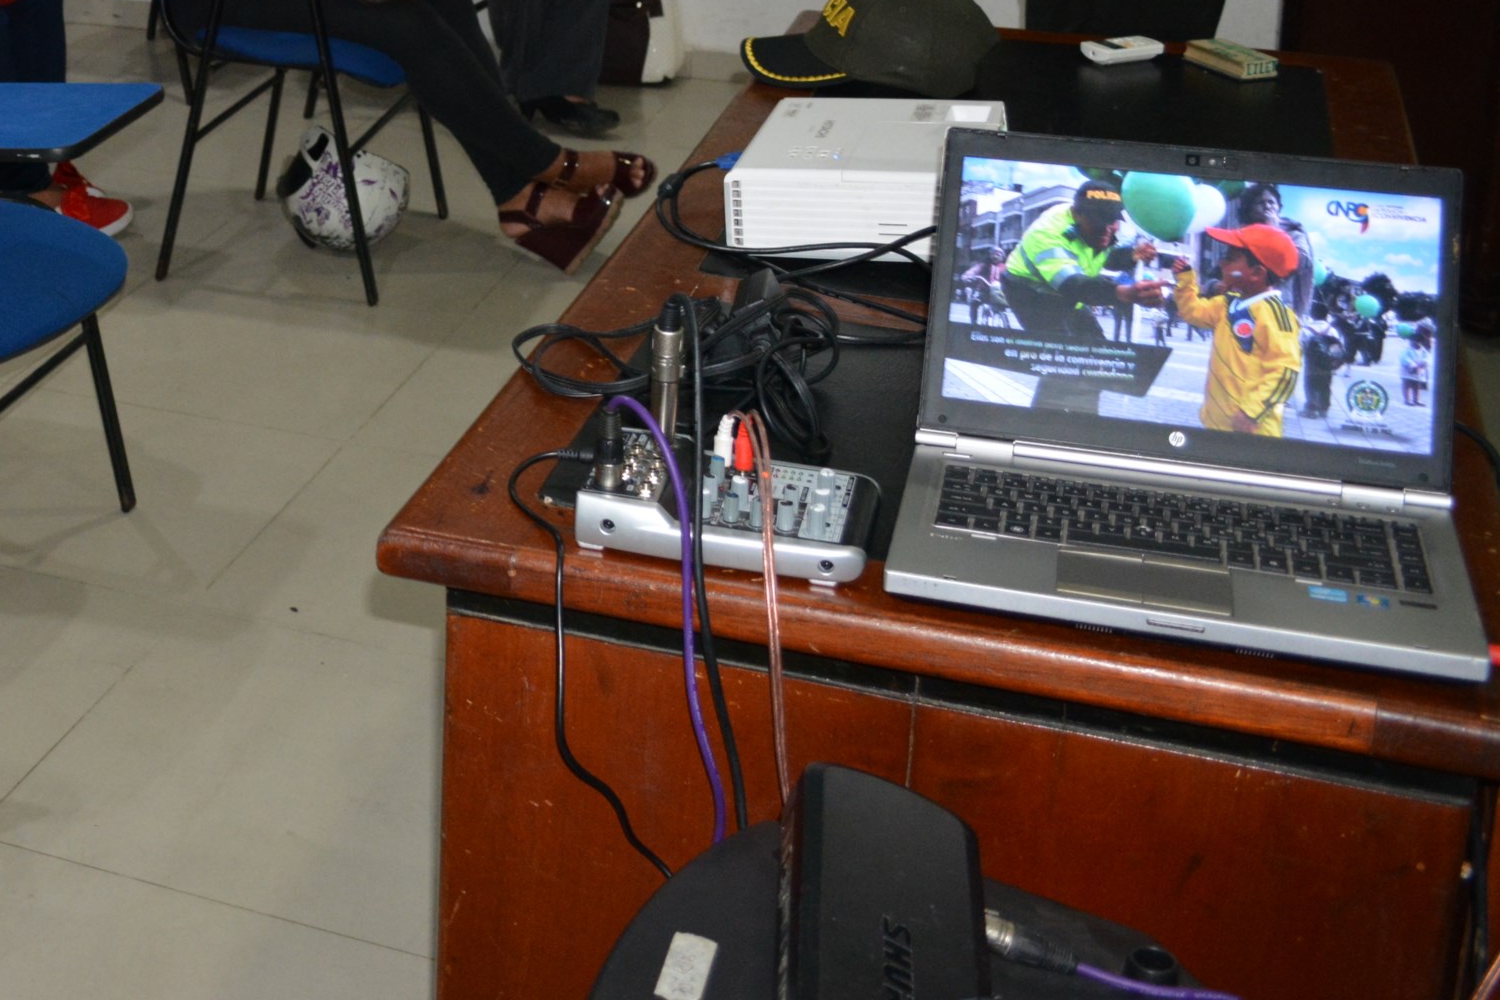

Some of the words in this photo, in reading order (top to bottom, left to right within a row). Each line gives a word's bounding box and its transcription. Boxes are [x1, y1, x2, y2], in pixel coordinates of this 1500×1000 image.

[1004, 349, 1018, 358] en
[1020, 351, 1037, 362] pro
[1039, 349, 1052, 361] de
[1054, 350, 1065, 362] la
[1066, 353, 1126, 369] convivencia
[1169, 431, 1185, 447] hp
